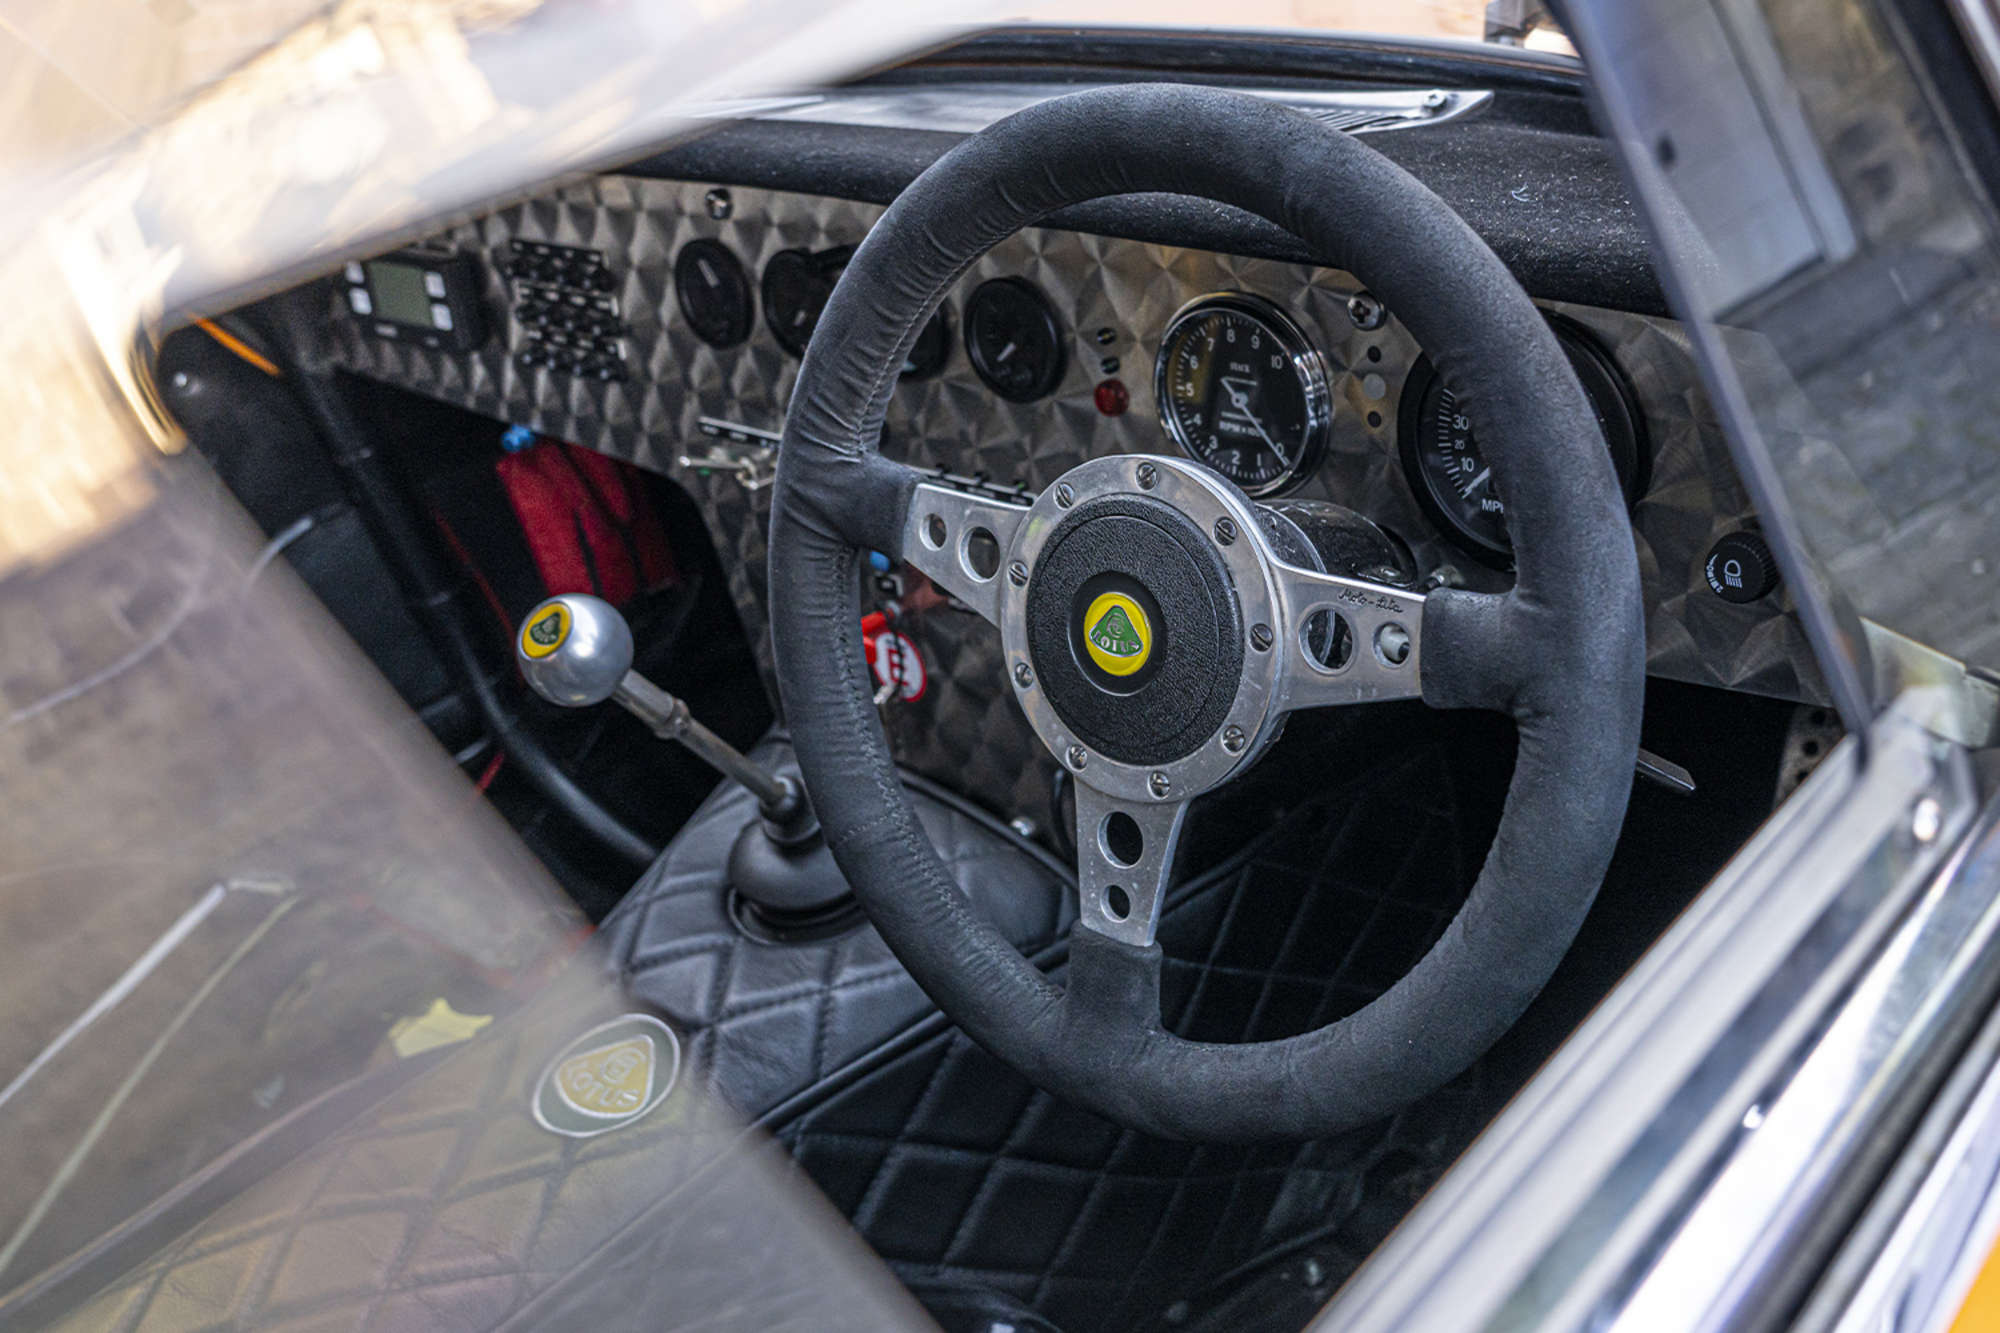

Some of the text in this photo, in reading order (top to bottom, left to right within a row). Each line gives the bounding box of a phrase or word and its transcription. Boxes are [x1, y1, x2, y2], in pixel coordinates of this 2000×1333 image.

[1227, 328, 1235, 343] 8
[1251, 335, 1260, 349] 9
[1207, 338, 1215, 352] 7
[1190, 356, 1198, 369] 6
[1271, 355, 1283, 369] 10
[1186, 383, 1194, 396] 5
[1193, 413, 1202, 425] 4
[1452, 414, 1469, 431] 30
[1209, 435, 1218, 449] 3
[1454, 439, 1465, 450] 20
[1231, 451, 1240, 465] 2
[1256, 453, 1262, 466] 1
[1460, 457, 1474, 473] 10
[567, 1061, 641, 1107] LOTUS
